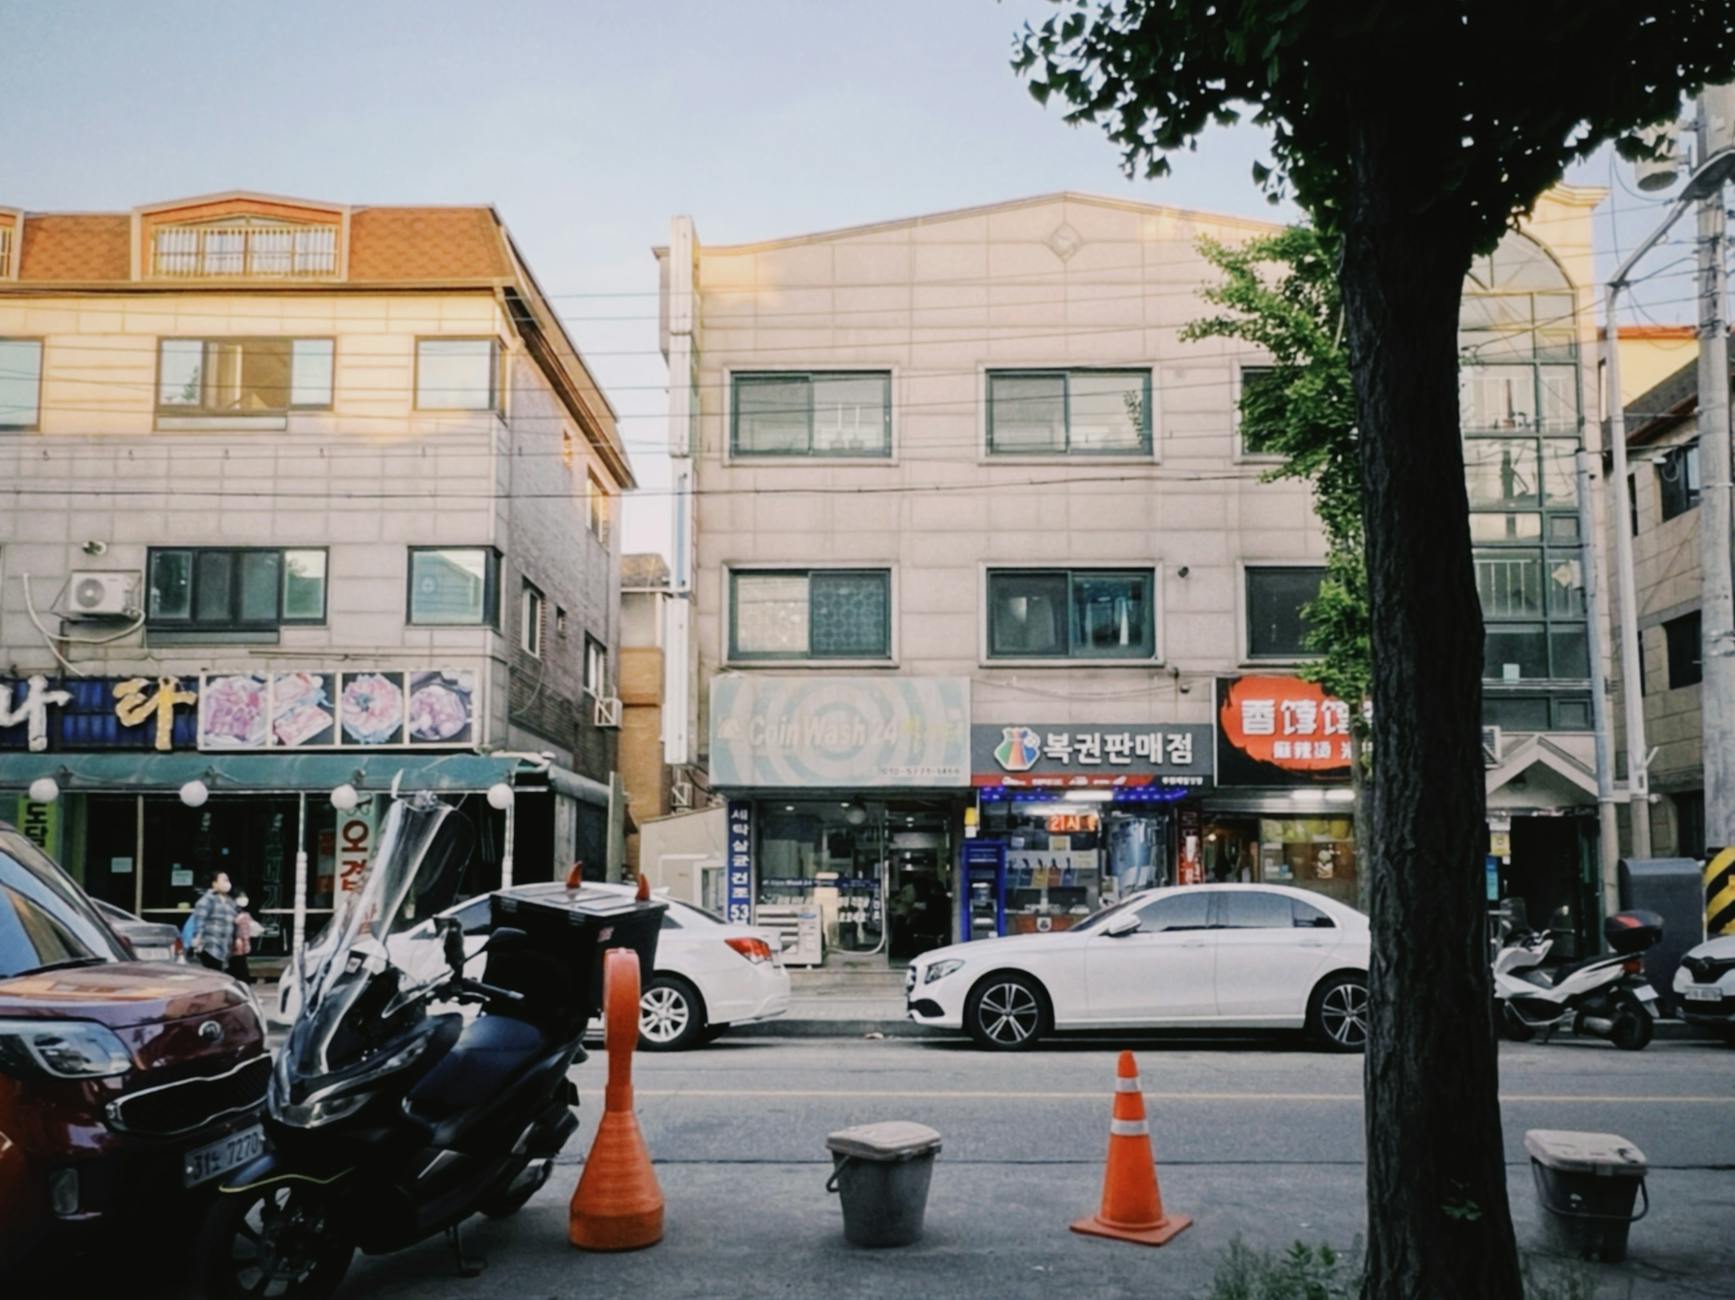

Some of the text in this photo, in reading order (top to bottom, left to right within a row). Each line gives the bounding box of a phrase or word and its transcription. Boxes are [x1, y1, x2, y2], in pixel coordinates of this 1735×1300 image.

[749, 714, 799, 746] Coin
[801, 715, 865, 746] Wash
[869, 716, 898, 746] 24
[1043, 731, 1193, 765] 복권판매점
[227, 1132, 259, 1166] 7270
